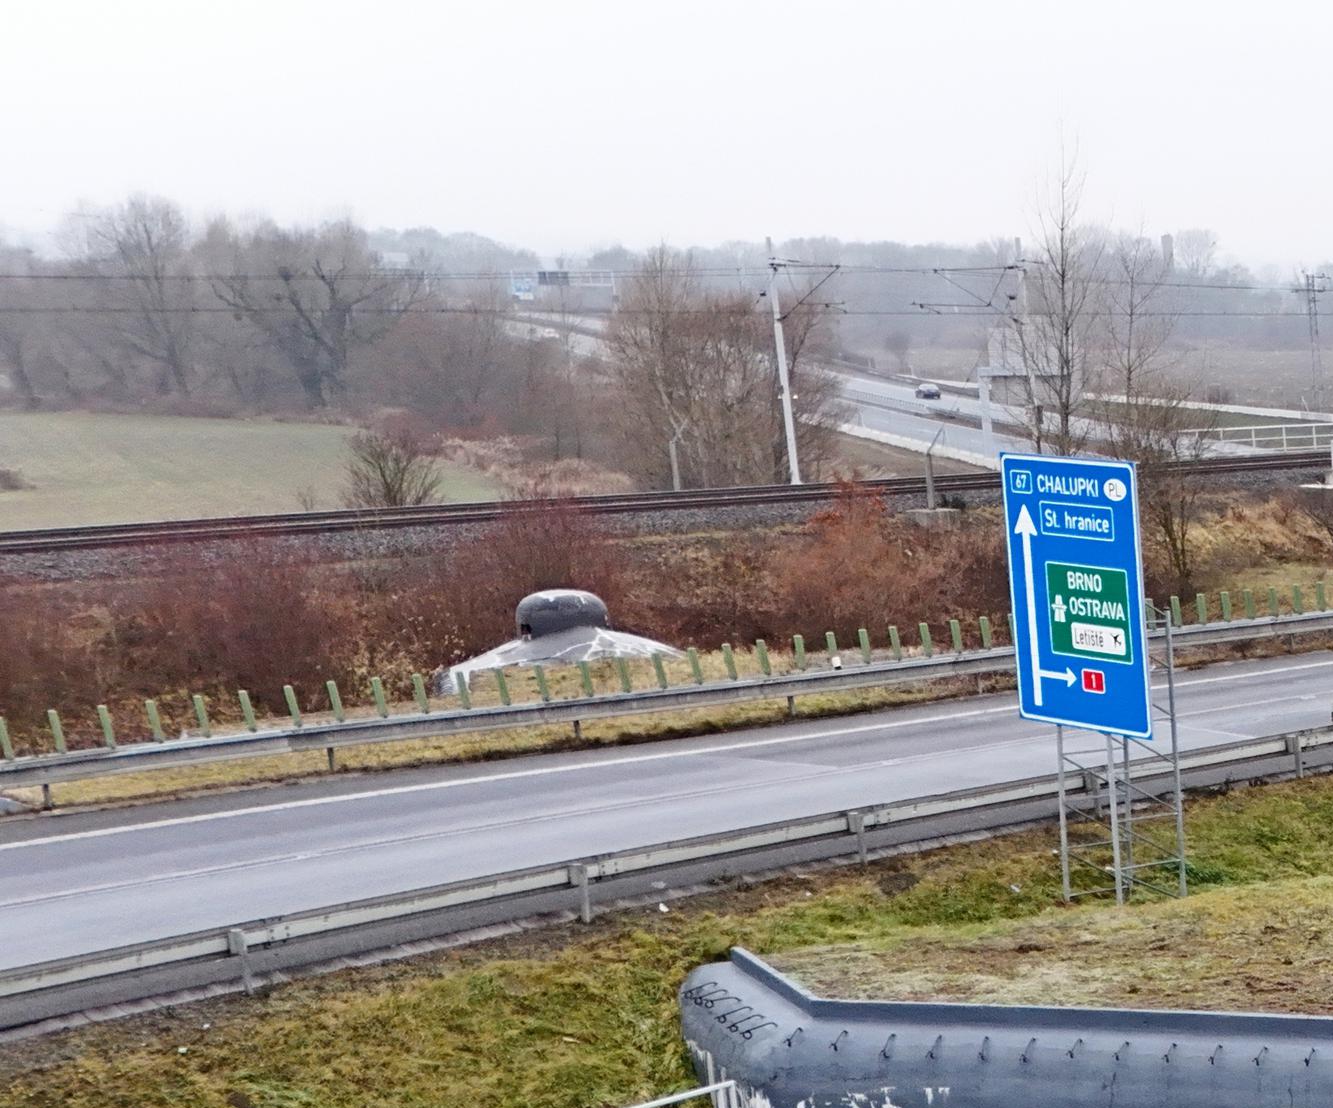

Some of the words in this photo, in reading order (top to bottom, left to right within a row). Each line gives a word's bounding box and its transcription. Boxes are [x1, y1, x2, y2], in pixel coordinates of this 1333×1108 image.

[1015, 474, 1027, 489] 67
[1037, 474, 1099, 497] CHALUPKI
[1109, 482, 1122, 498] PL
[1064, 511, 1110, 533] hranice
[1066, 570, 1102, 593] BRNO
[1069, 596, 1126, 621] OSTRAVA
[1090, 673, 1097, 689] 1
